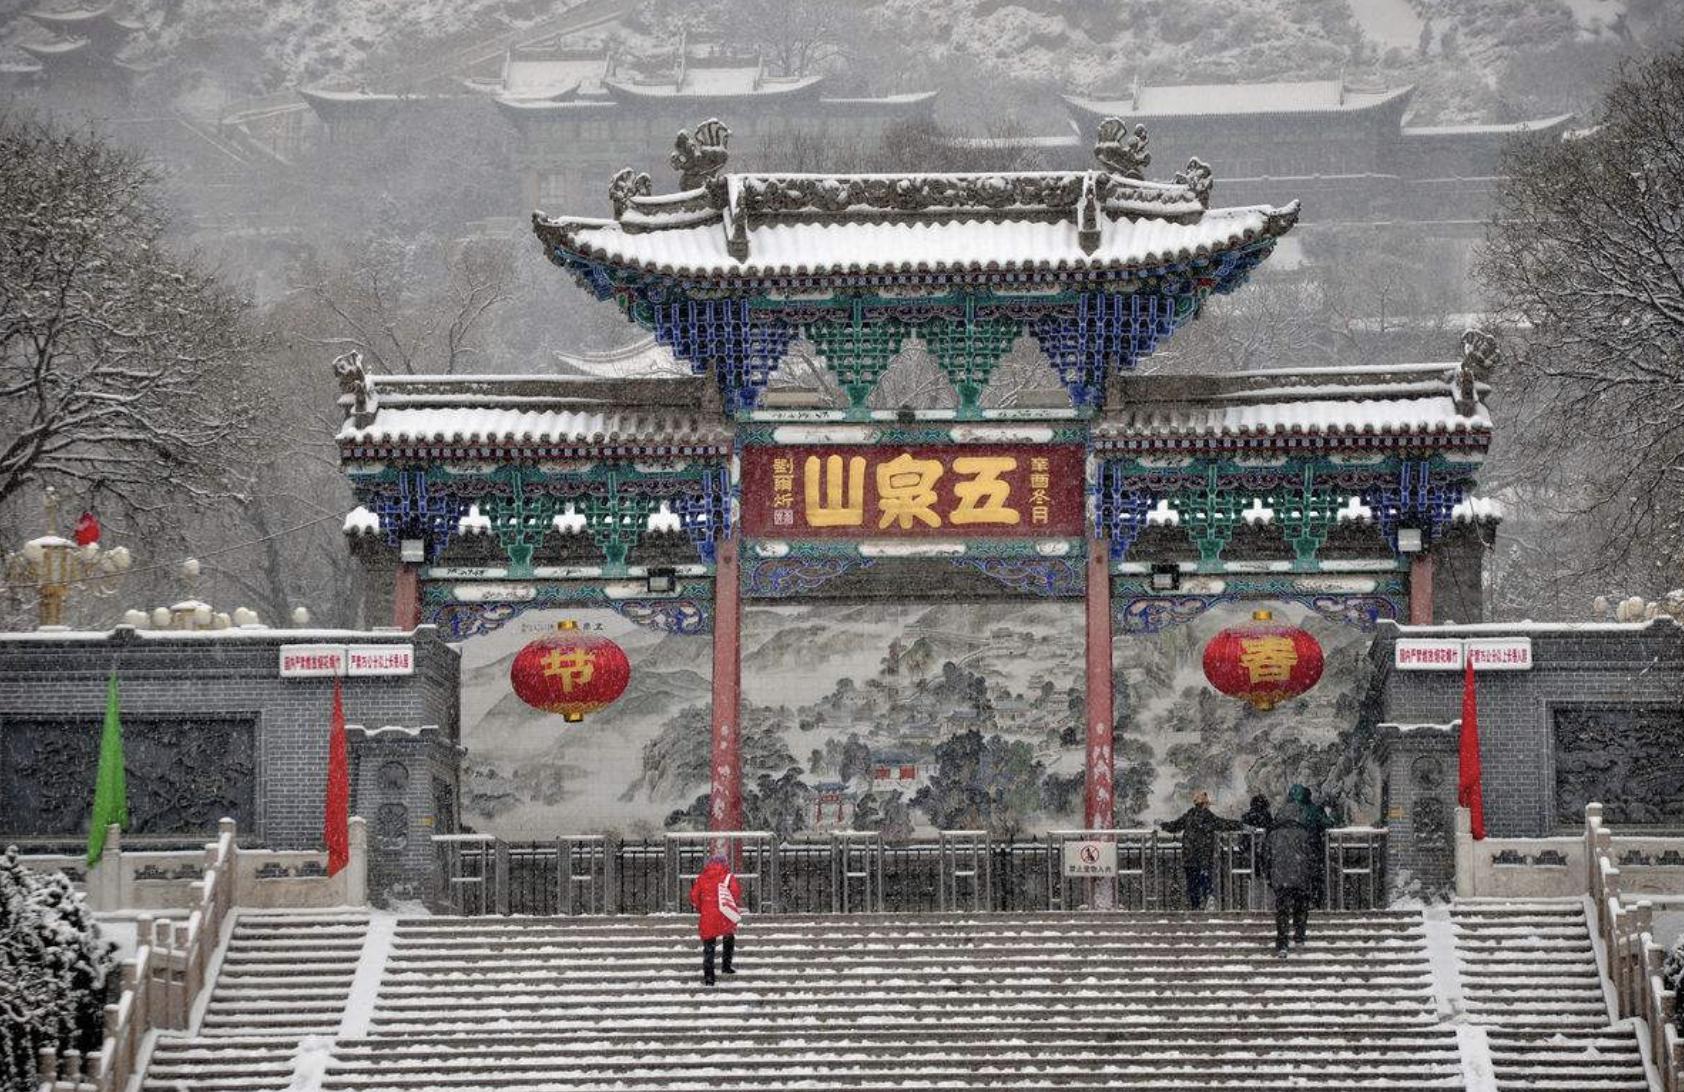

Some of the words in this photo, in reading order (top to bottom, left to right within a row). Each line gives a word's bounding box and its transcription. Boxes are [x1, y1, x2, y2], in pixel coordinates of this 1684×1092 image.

[804, 453, 1021, 529] 五泉山
[540, 647, 596, 694] 节
[1239, 636, 1297, 683] 春
